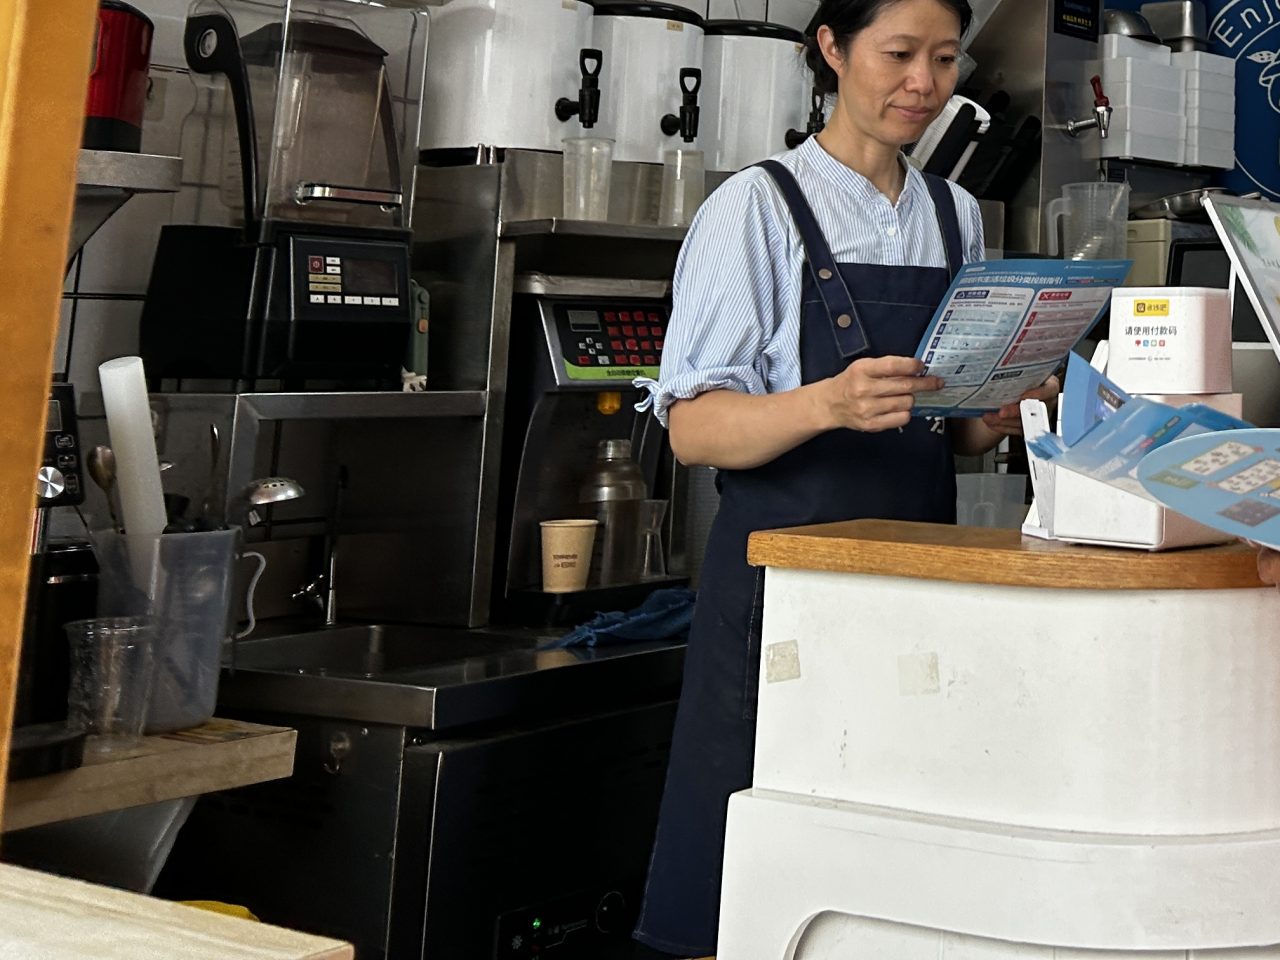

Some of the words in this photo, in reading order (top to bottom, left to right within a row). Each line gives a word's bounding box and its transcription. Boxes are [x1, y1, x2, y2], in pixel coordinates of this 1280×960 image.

[1124, 325, 1178, 337] 请使用付款码
